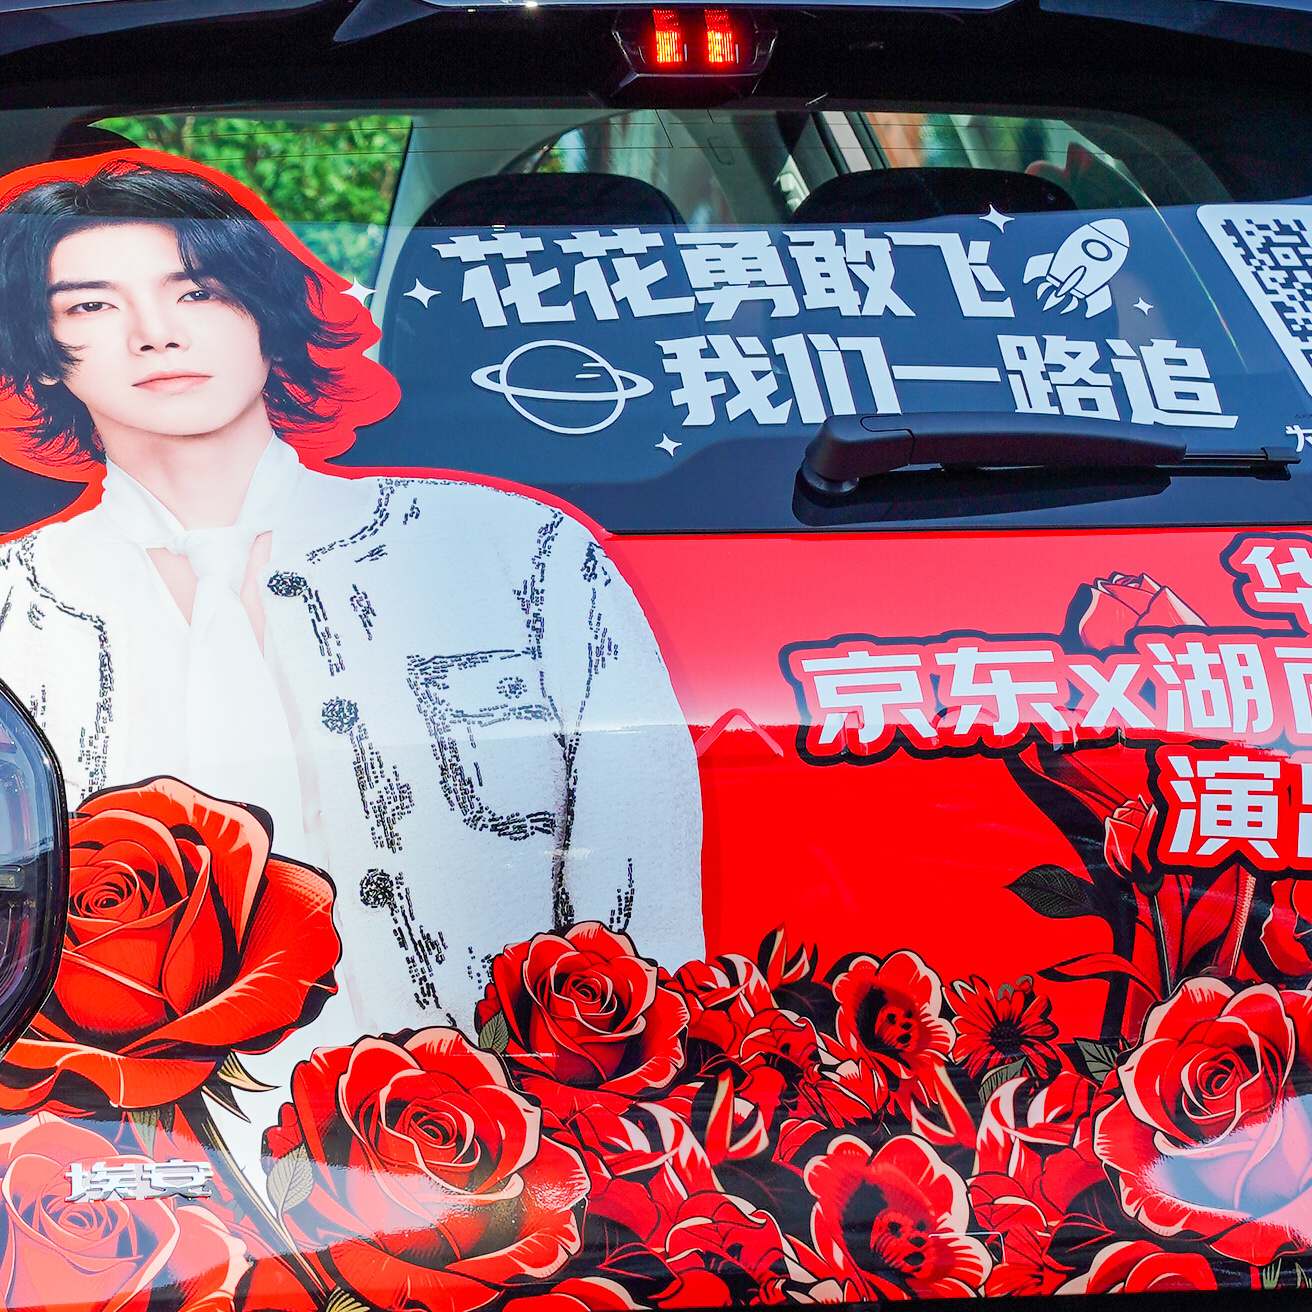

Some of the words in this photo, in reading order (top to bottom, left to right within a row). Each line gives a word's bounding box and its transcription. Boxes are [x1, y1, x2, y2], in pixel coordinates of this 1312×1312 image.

[431, 228, 1016, 328] 花花勇敢飞
[654, 333, 1239, 430] 我们一路追
[1168, 755, 1312, 859] 演
[64, 1159, 214, 1203] 埃安
